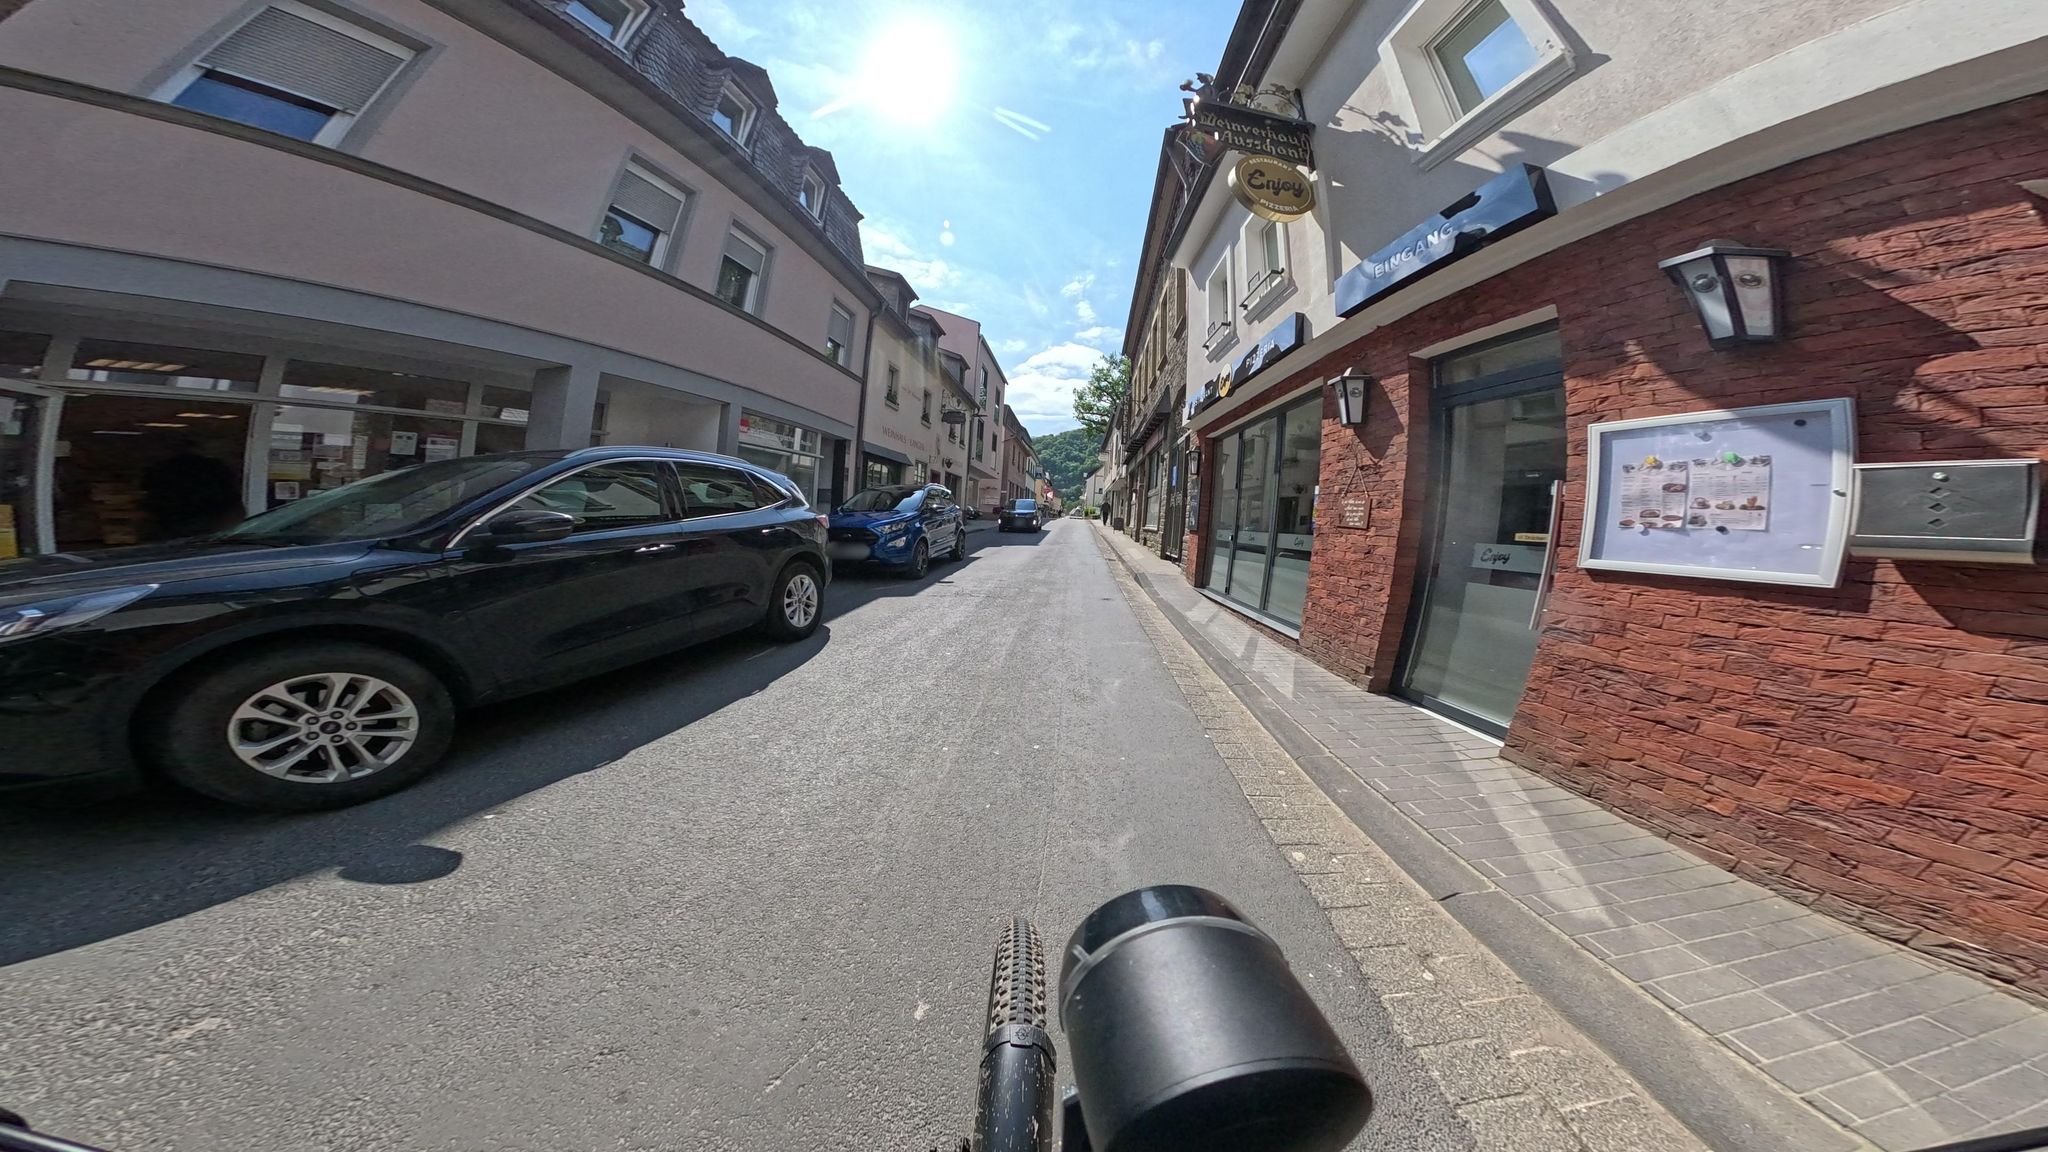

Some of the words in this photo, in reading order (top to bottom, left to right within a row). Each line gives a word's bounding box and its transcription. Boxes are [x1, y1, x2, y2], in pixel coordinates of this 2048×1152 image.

[1247, 169, 1304, 198] Enjoy
[1260, 198, 1300, 213] PIZZERIA
[1374, 222, 1453, 279] EINGANG
[1480, 547, 1511, 565] Enjoy
